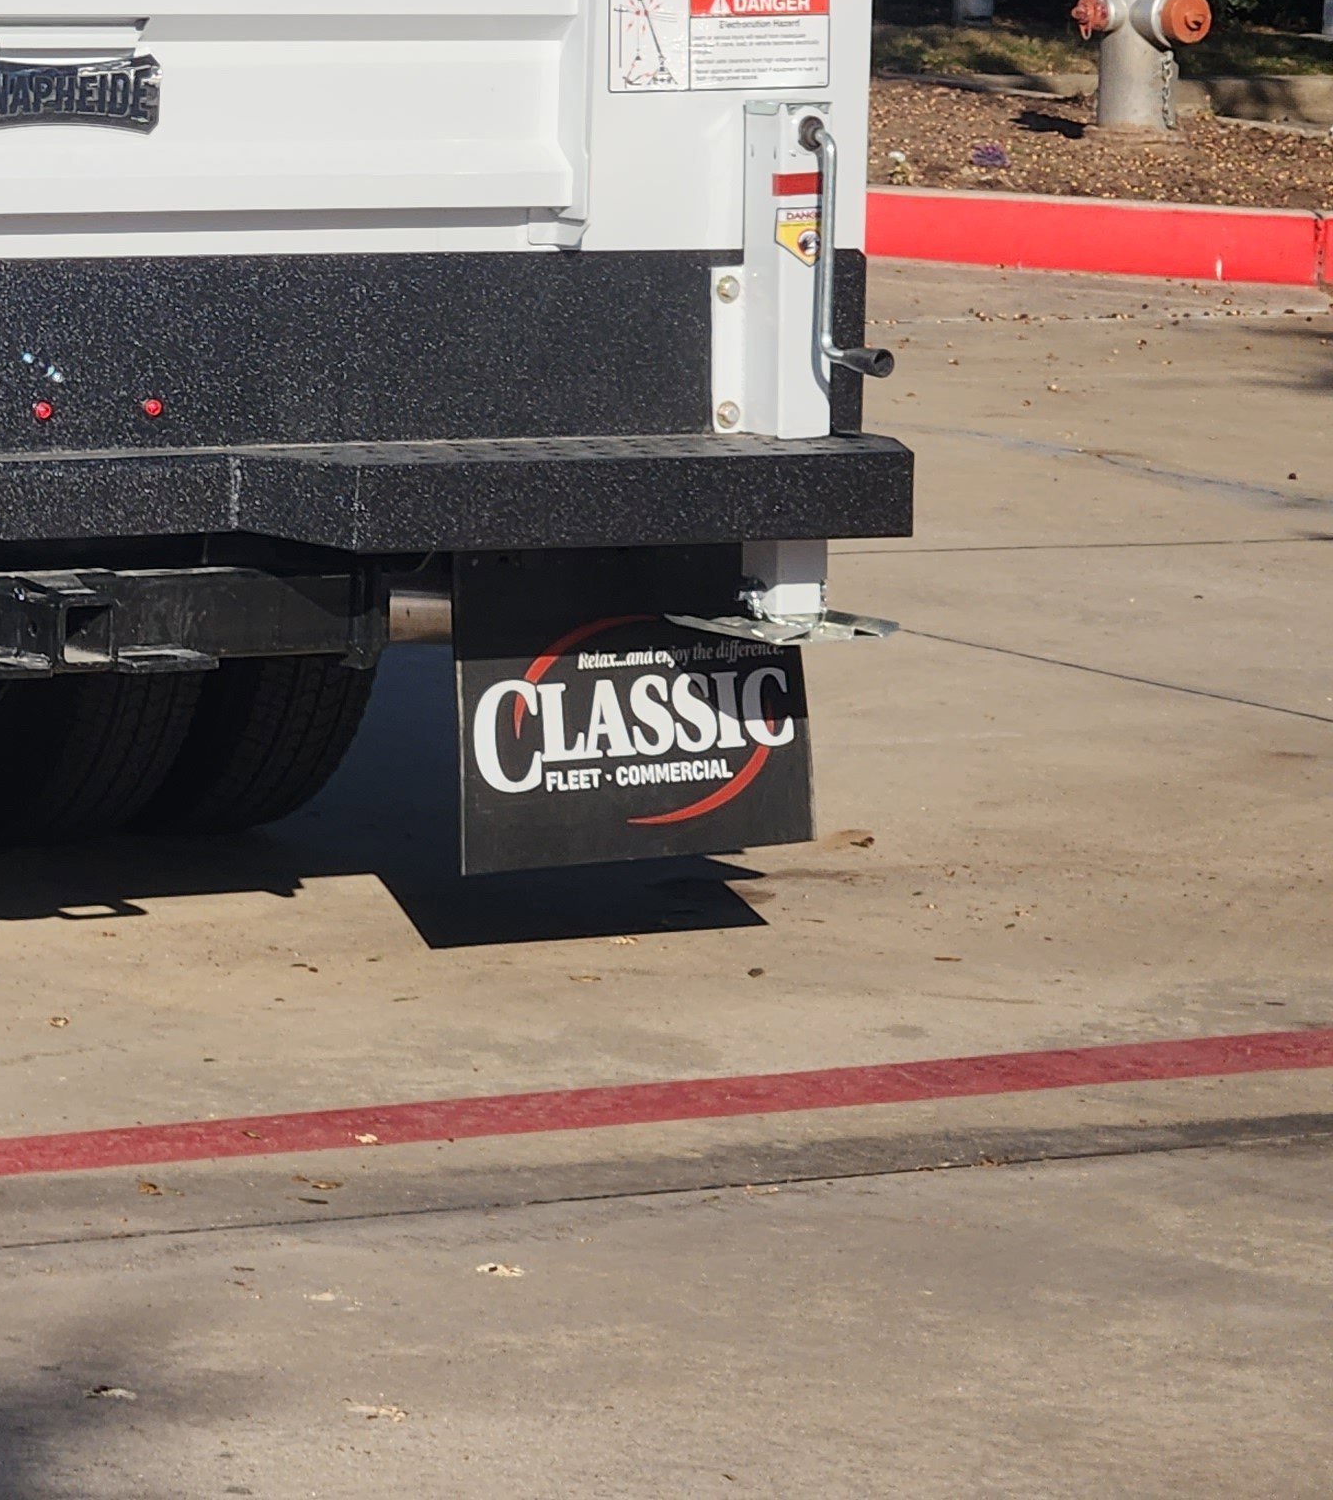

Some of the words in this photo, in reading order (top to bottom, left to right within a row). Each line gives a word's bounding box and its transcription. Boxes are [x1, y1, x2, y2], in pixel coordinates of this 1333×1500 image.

[654, 648, 691, 668] enjoy
[692, 642, 715, 660] the
[473, 666, 795, 793] CLASSIC
[545, 768, 601, 792] FLEET
[615, 758, 734, 787] COMMERCIAL
